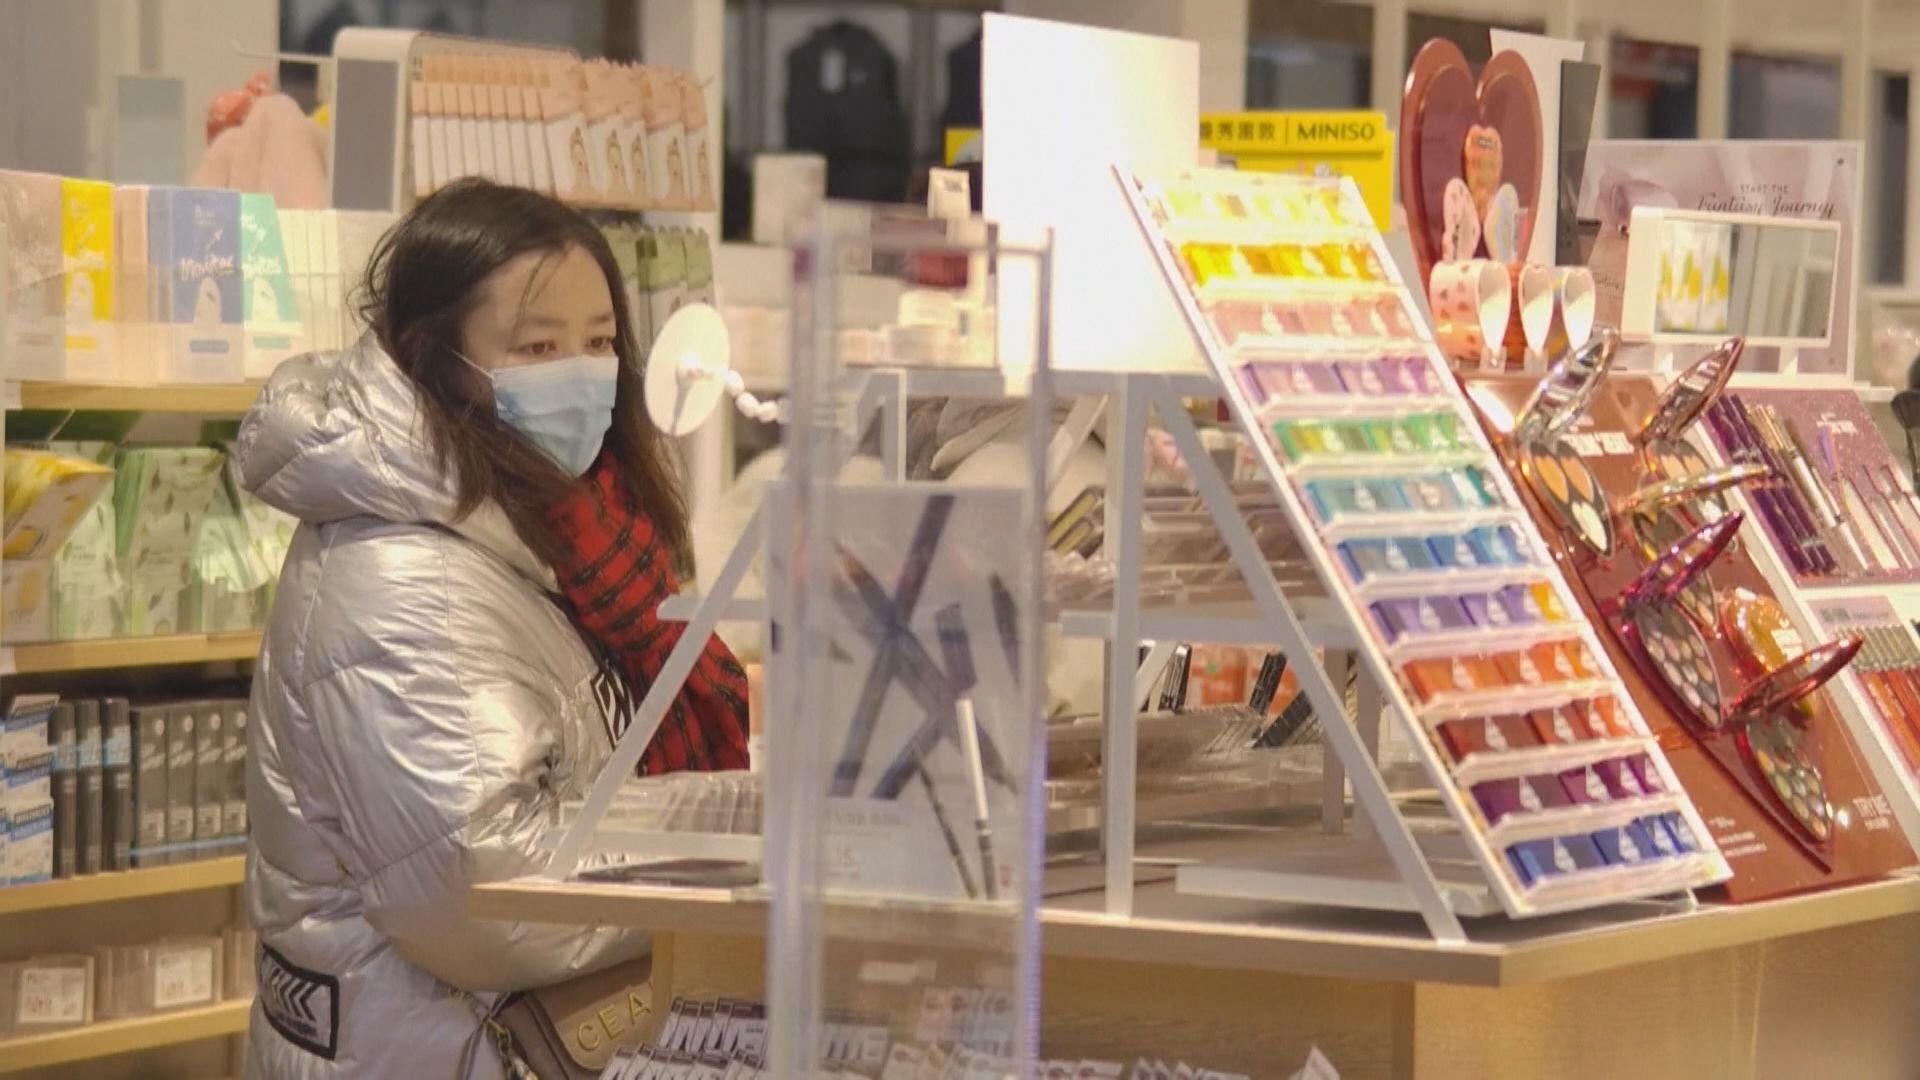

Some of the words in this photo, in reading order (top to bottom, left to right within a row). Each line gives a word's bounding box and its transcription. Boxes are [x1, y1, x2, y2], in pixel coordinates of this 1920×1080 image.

[1297, 122, 1375, 141] MINISO
[1772, 184, 1790, 195] THE
[1697, 192, 1763, 215] Fantasy
[1771, 195, 1835, 219] Journey
